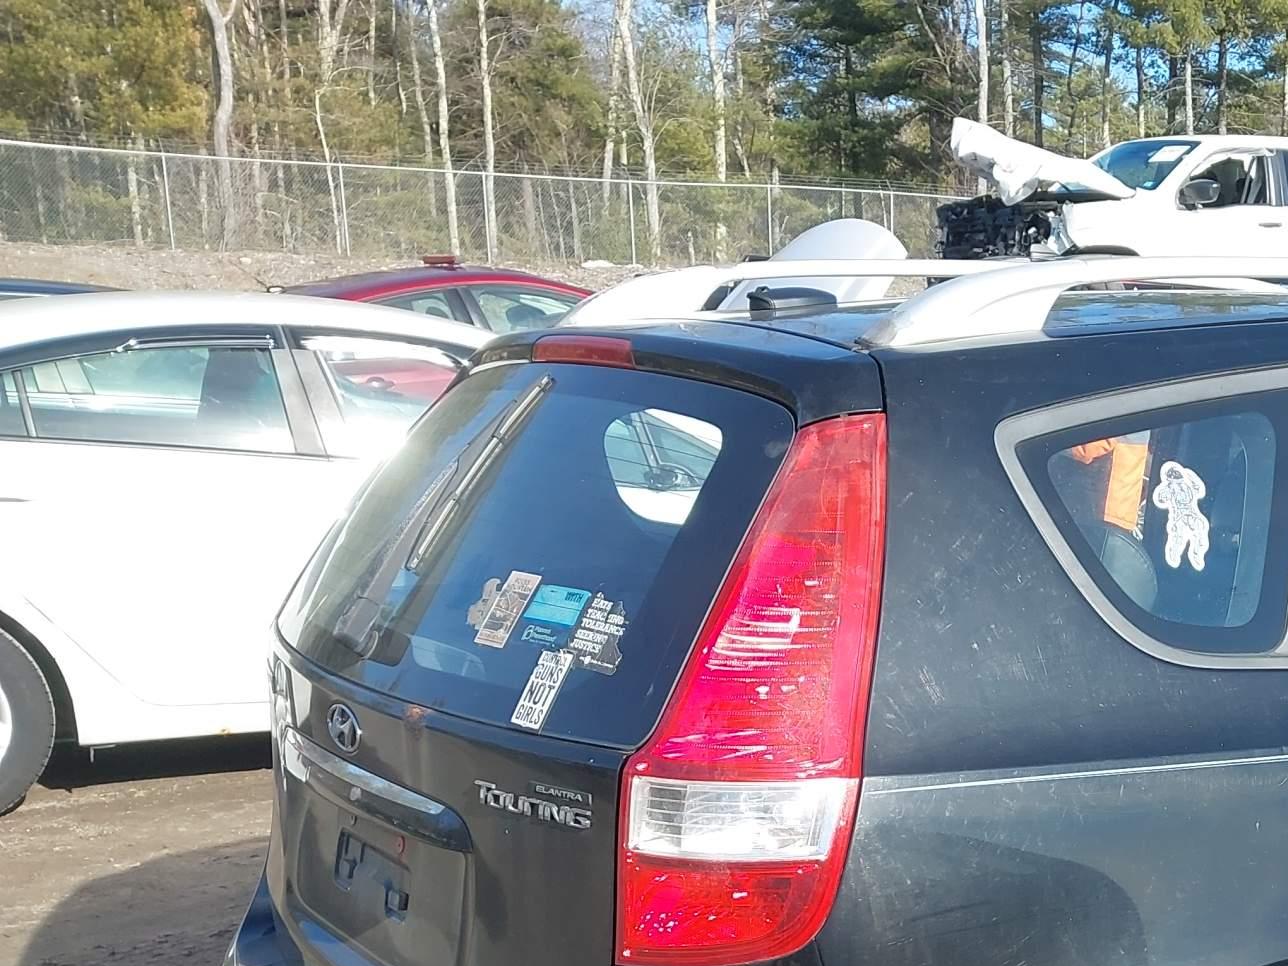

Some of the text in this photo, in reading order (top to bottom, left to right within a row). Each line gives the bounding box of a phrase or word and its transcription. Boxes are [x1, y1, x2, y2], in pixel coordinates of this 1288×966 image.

[534, 663, 563, 684] GUNS
[523, 681, 556, 708] NOT
[514, 703, 544, 725] GIRLS
[535, 784, 583, 802] ELANTRA
